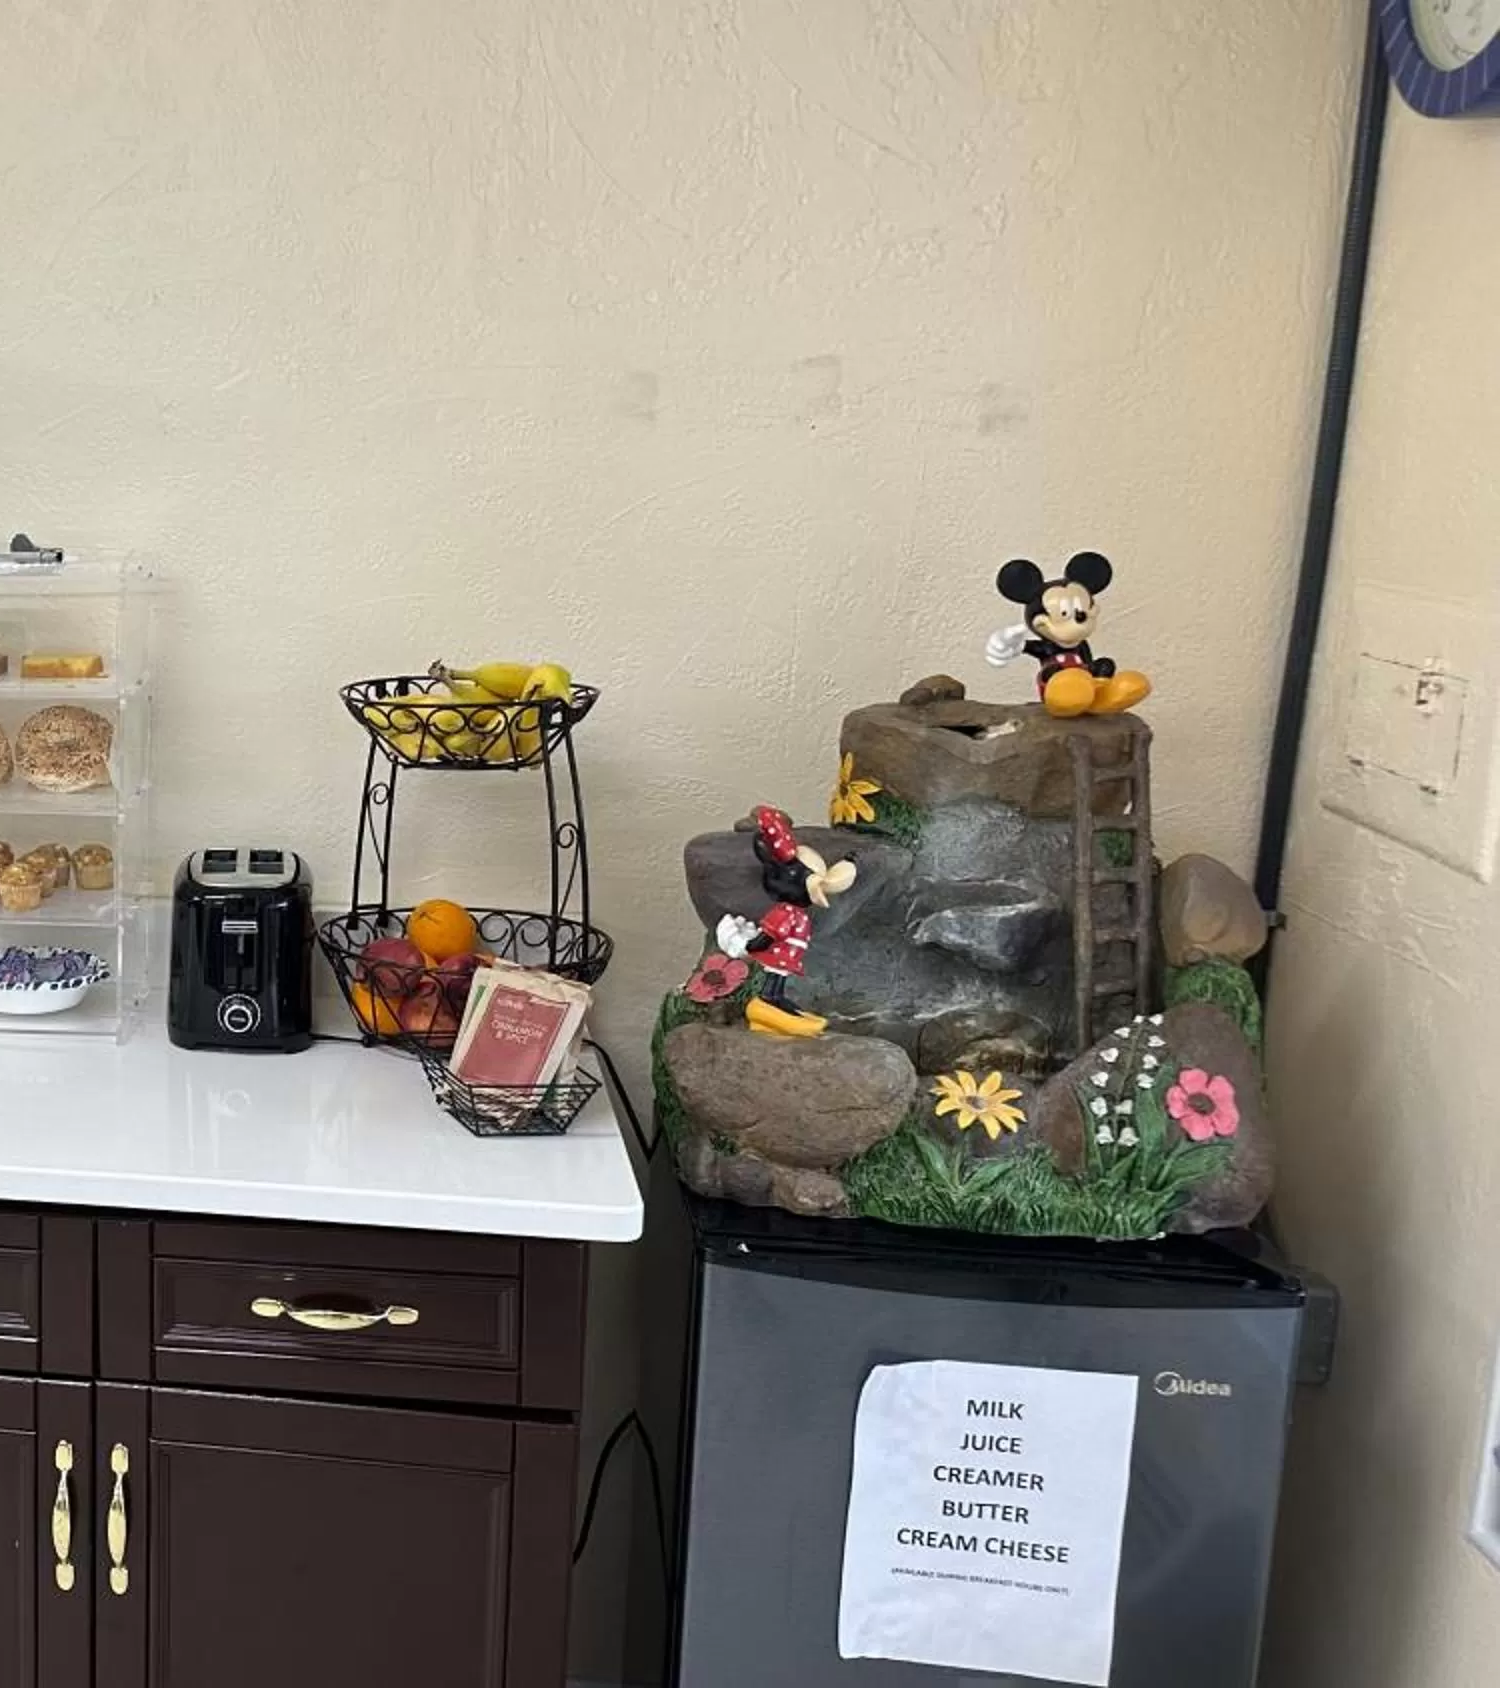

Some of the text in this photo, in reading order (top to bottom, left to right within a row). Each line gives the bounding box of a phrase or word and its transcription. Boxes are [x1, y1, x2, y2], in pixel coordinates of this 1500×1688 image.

[1153, 1371, 1232, 1397] Midea
[966, 1399, 1025, 1420] MILK
[959, 1433, 1023, 1455] JUICE
[933, 1465, 1044, 1491] CREAMER
[942, 1499, 1029, 1524] BUTTER
[897, 1527, 1070, 1563] CREAM CHEESE
